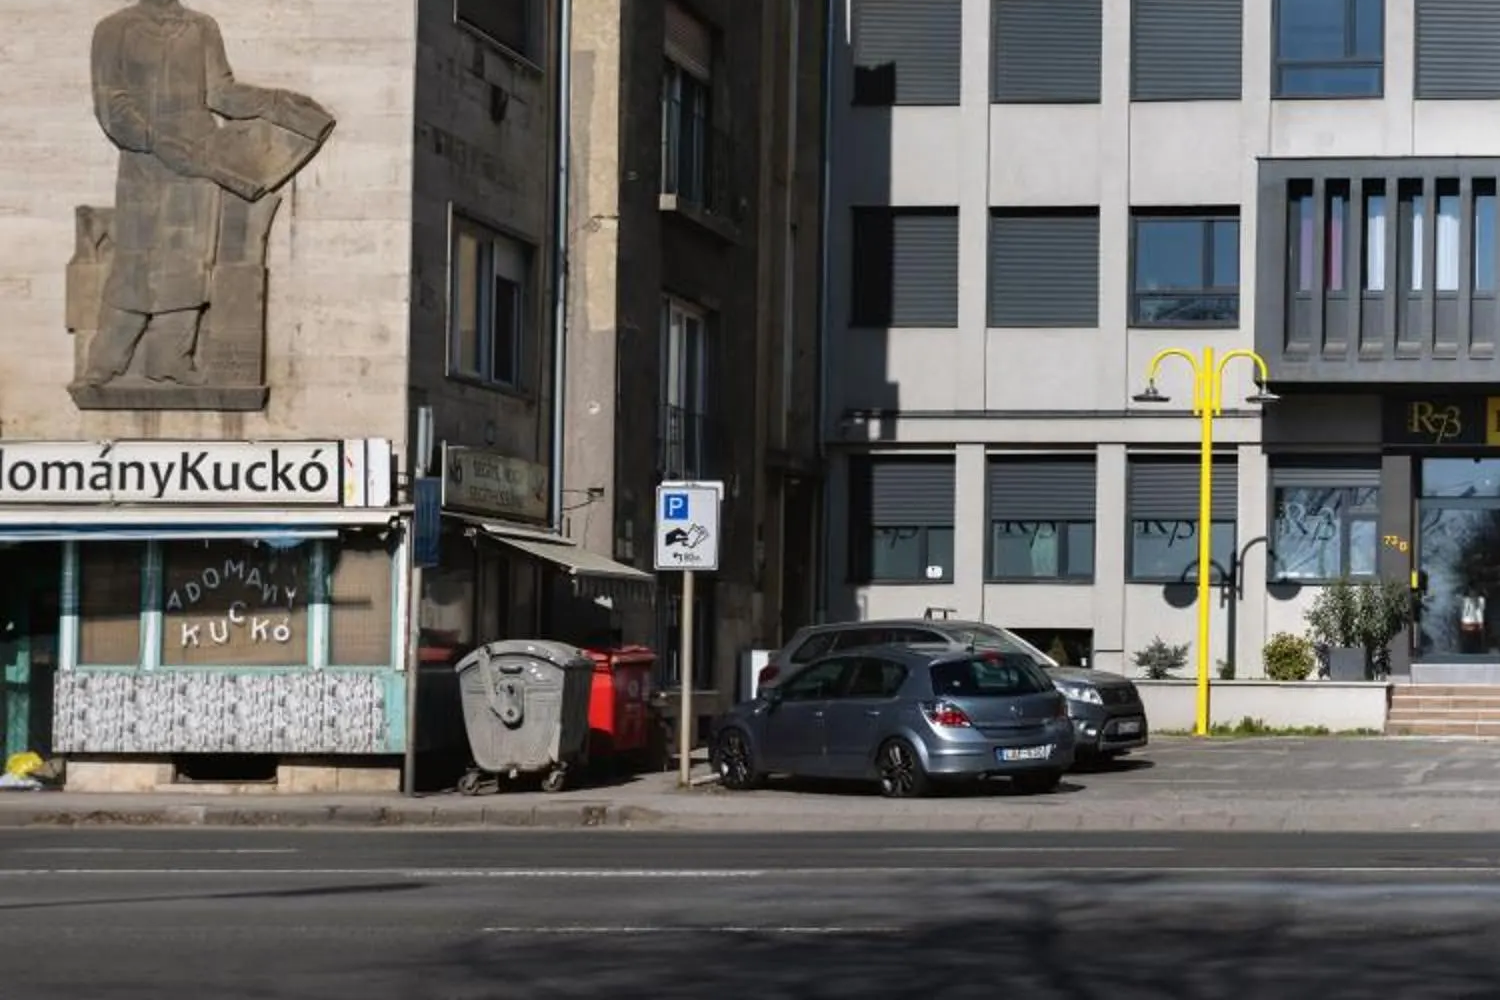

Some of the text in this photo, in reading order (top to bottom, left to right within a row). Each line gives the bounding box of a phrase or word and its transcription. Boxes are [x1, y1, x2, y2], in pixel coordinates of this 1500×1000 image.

[1408, 401, 1461, 444] R73
[0, 448, 329, 499] ományKuckó
[669, 497, 683, 517] P
